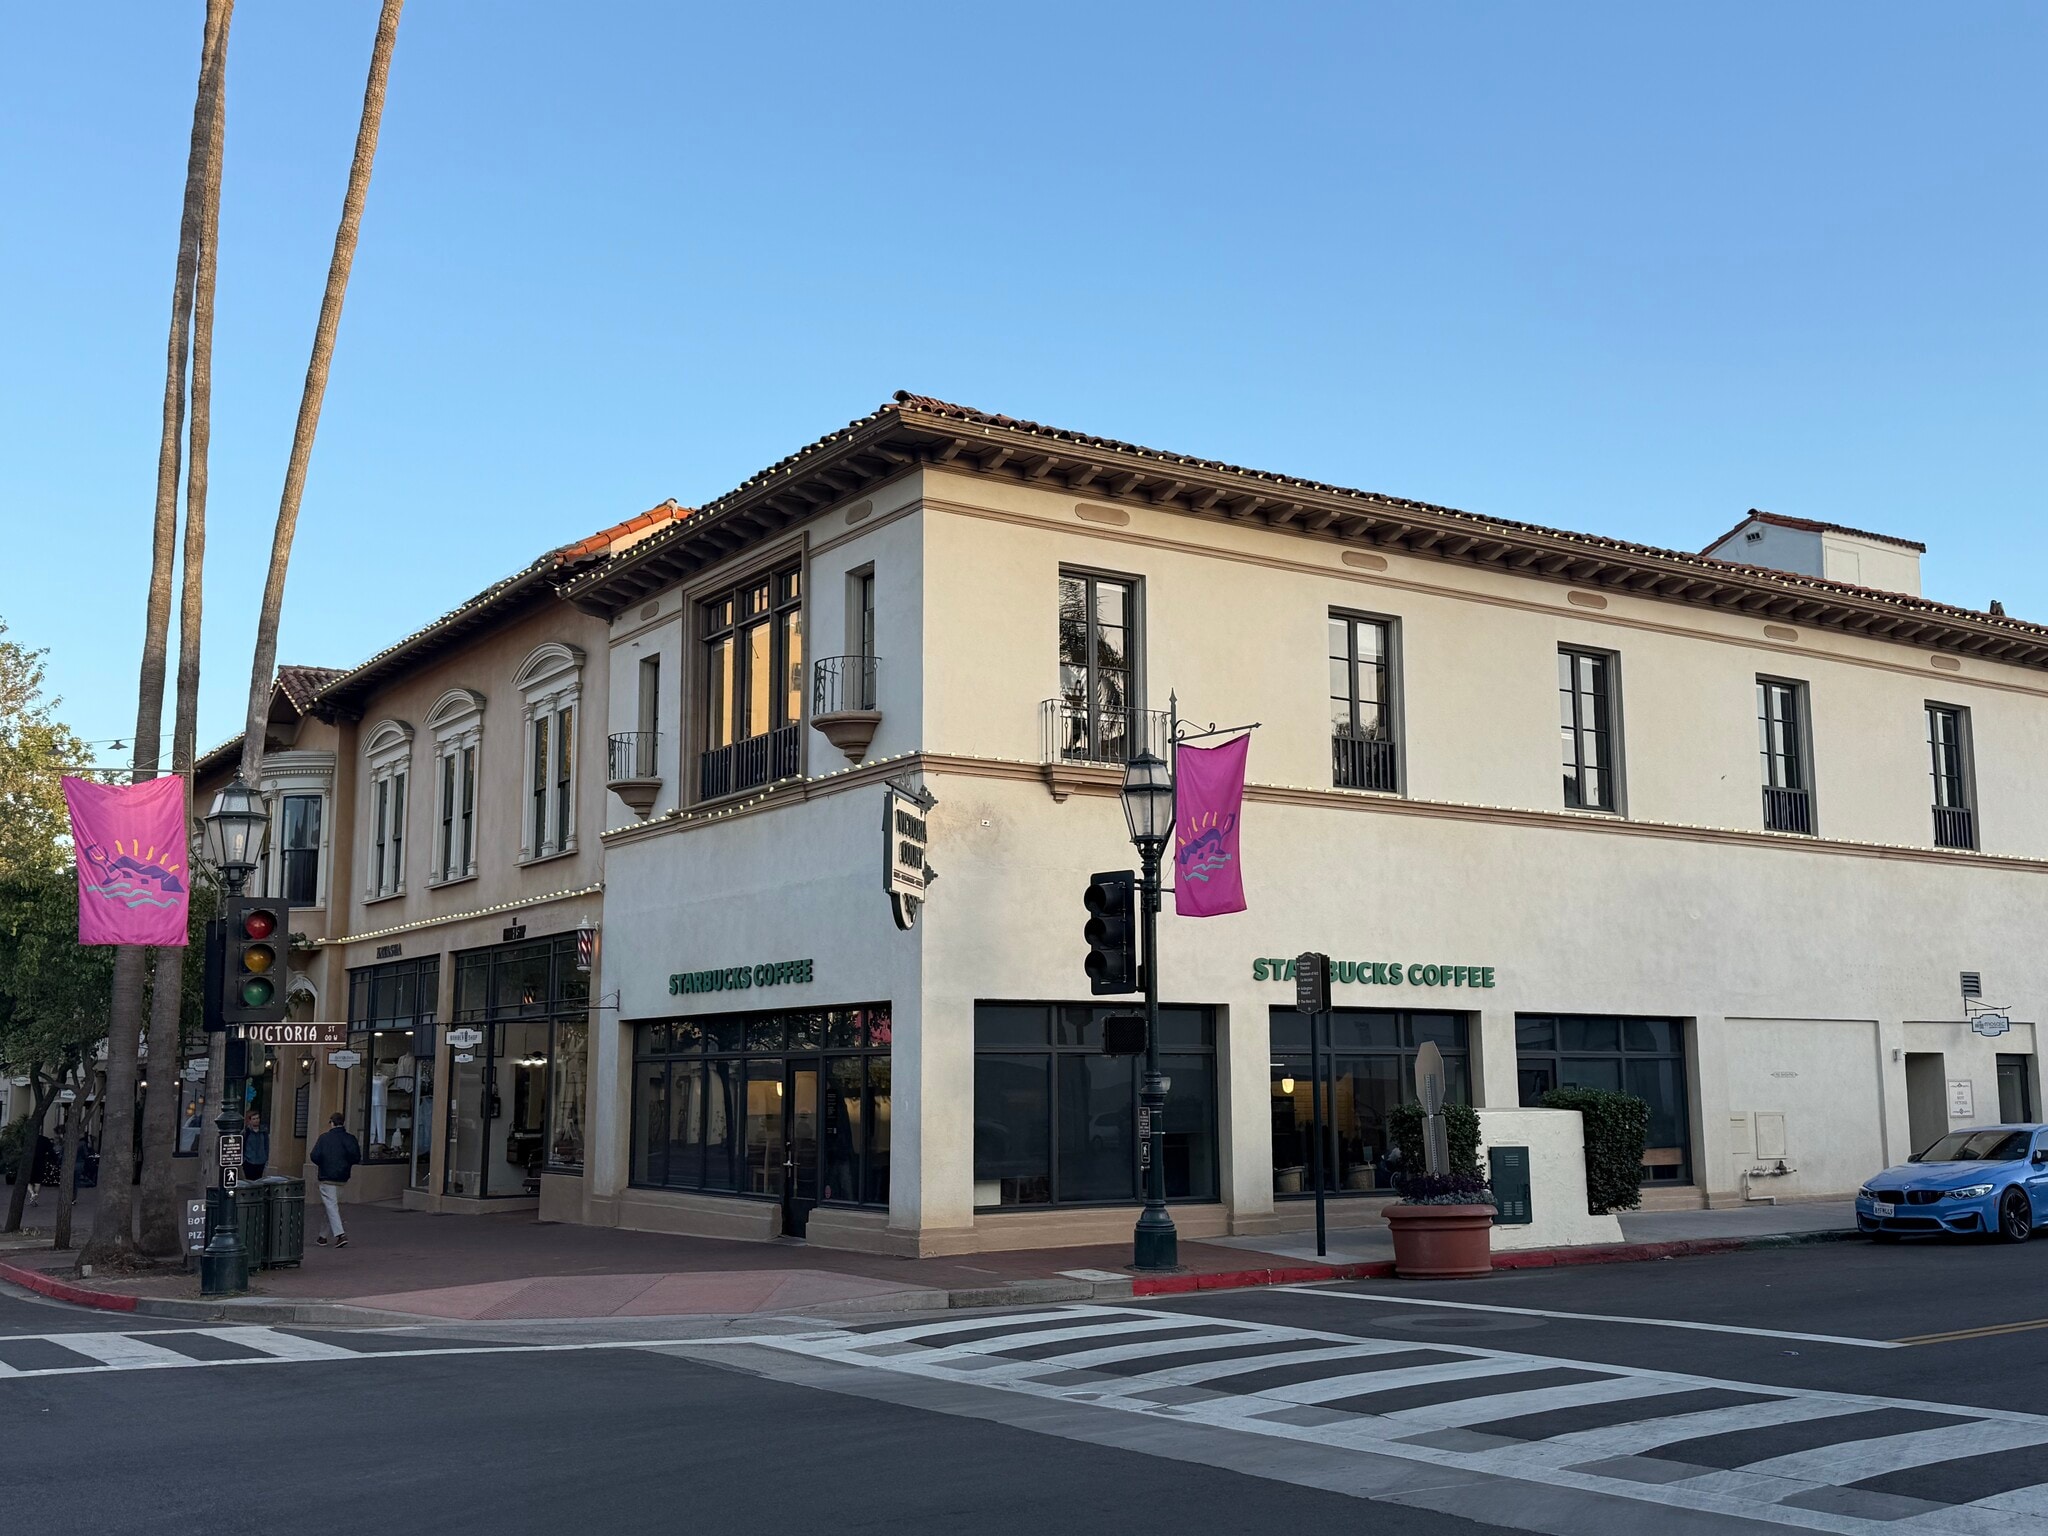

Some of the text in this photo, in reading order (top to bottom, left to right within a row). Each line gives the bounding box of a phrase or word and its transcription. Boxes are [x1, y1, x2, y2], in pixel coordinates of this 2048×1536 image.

[895, 809, 927, 843] VICTORIA
[898, 841, 924, 869] COURT
[669, 958, 813, 995] STARBUCKS COFFEE
[1253, 958, 1495, 988] STABUCKS COFFEE
[249, 1026, 317, 1041] VICTORIA
